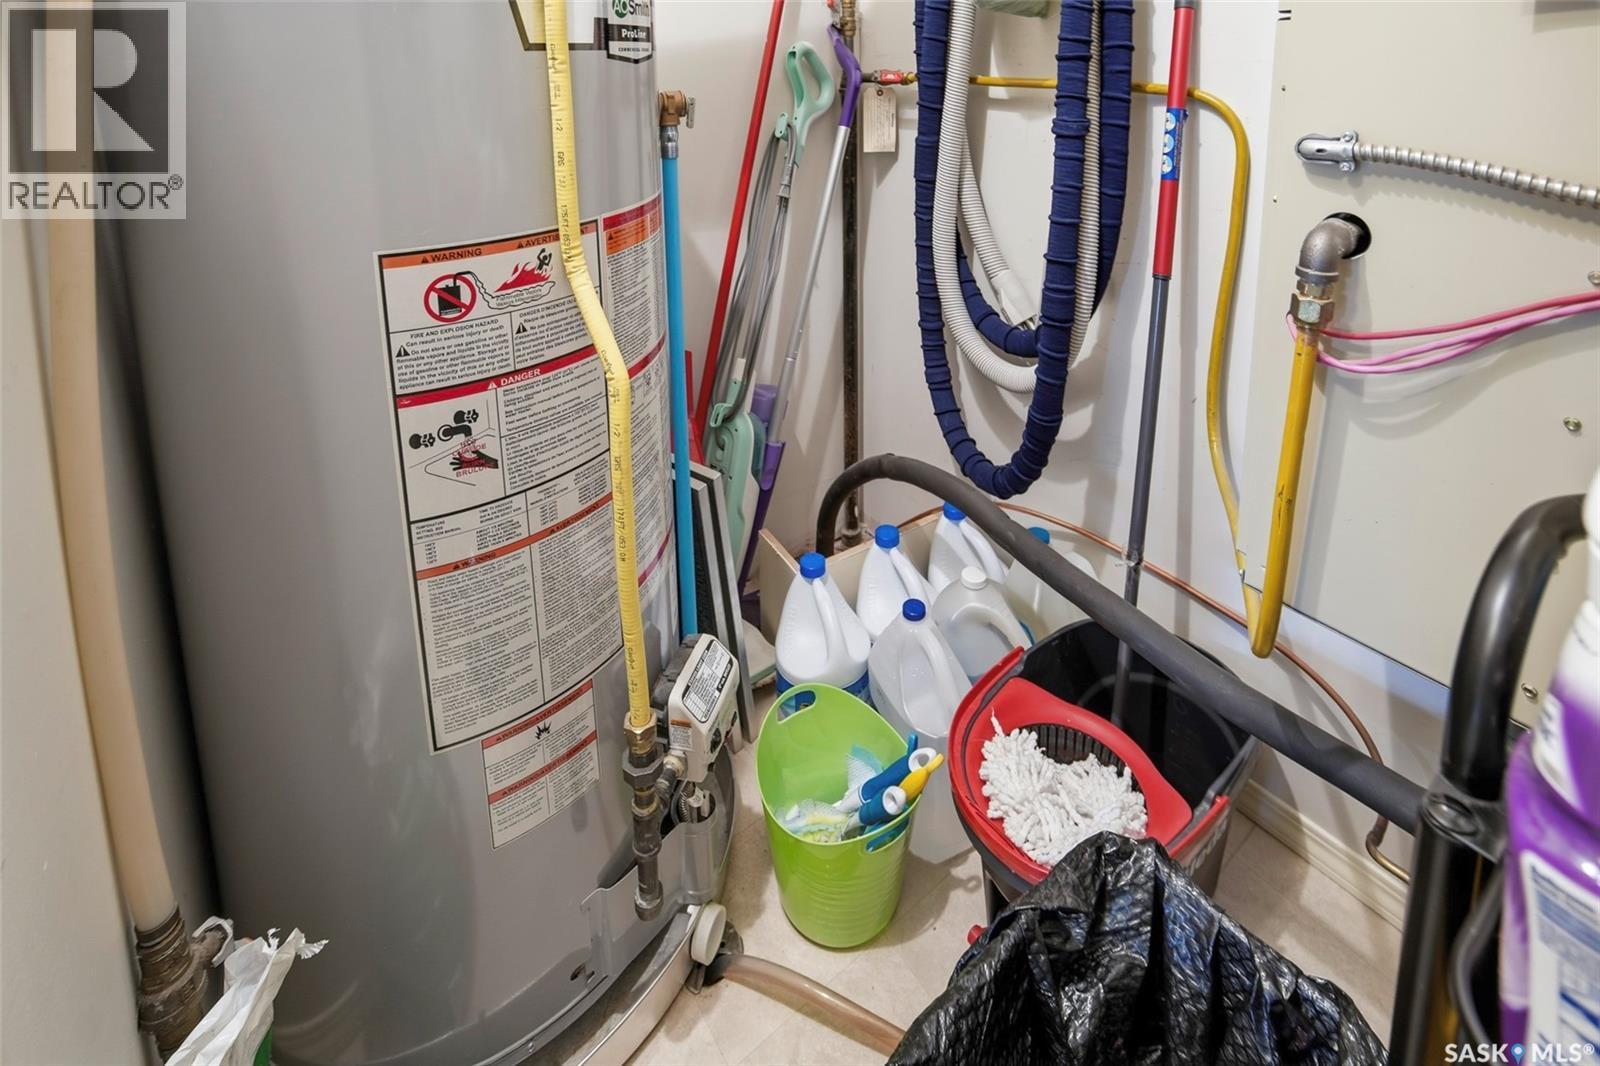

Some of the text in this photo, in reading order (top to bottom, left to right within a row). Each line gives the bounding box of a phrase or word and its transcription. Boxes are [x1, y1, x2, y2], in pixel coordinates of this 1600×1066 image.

[622, 29, 646, 38] ProLine
[431, 248, 482, 262] WARNING
[500, 369, 541, 386] DANGER
